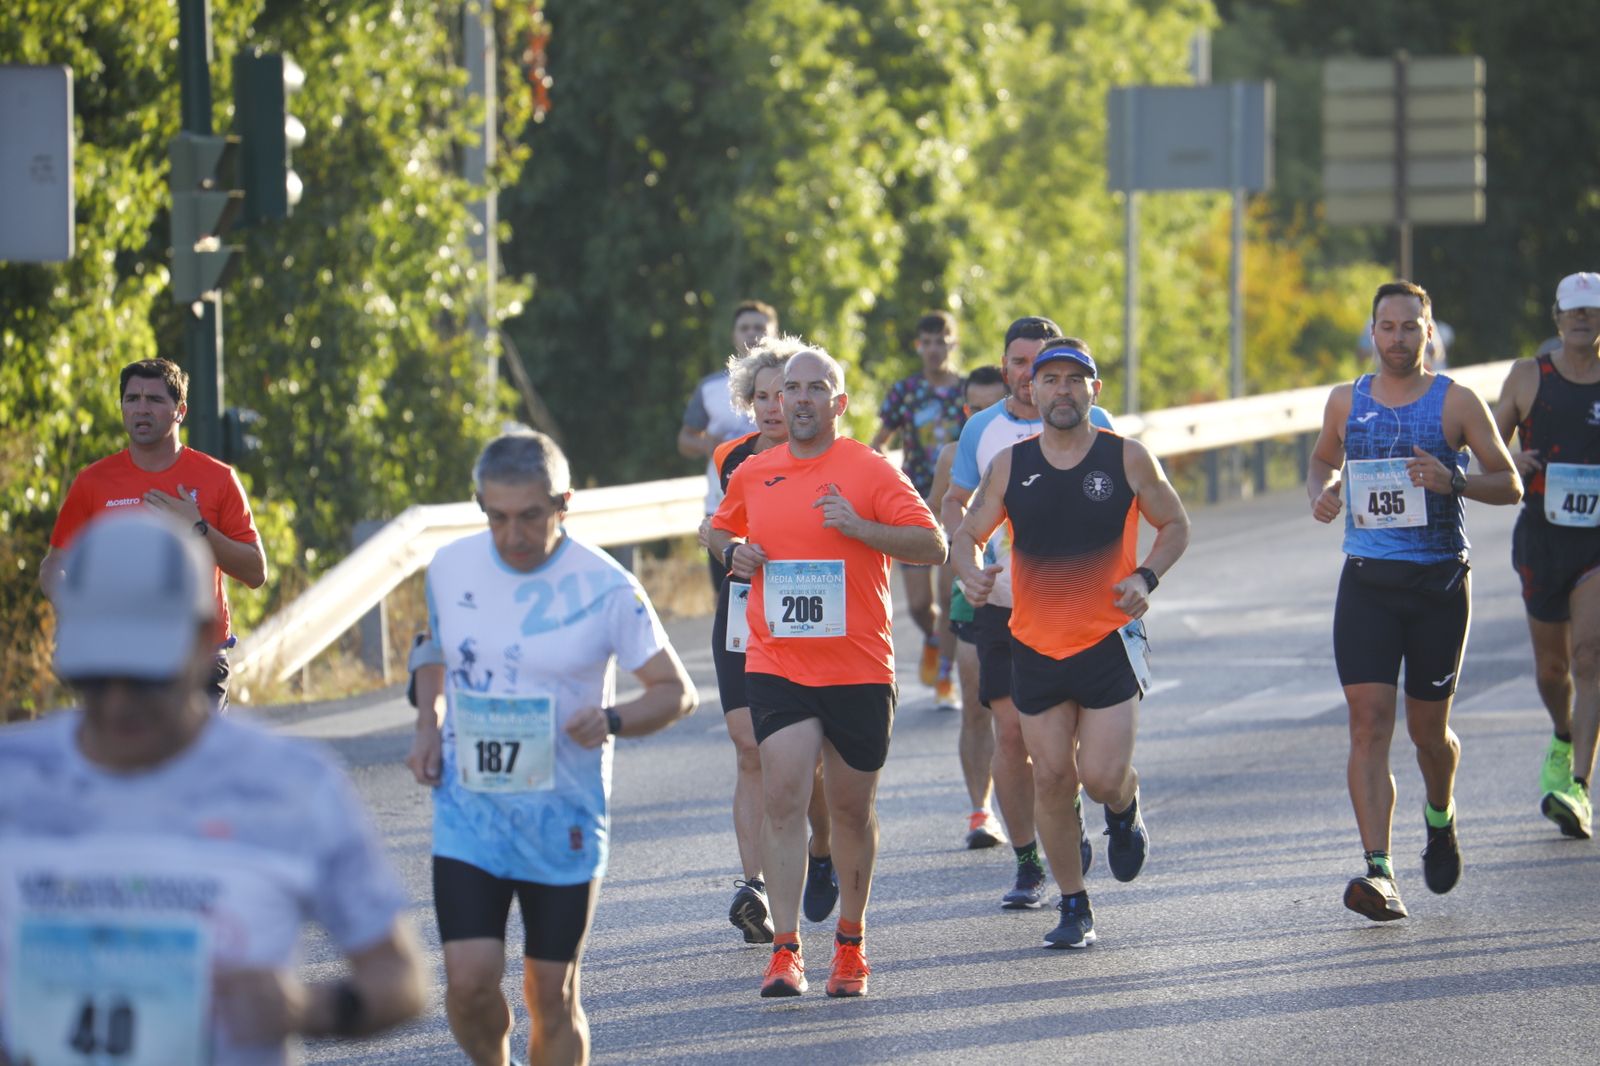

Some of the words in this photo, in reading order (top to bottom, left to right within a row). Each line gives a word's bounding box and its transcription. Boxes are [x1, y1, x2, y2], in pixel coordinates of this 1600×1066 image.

[1368, 489, 1405, 516] 435
[1561, 493, 1599, 515] 407
[767, 575, 793, 584] MEDIA
[782, 595, 823, 624] 206
[475, 740, 521, 773] 187
[65, 998, 136, 1057] 40
